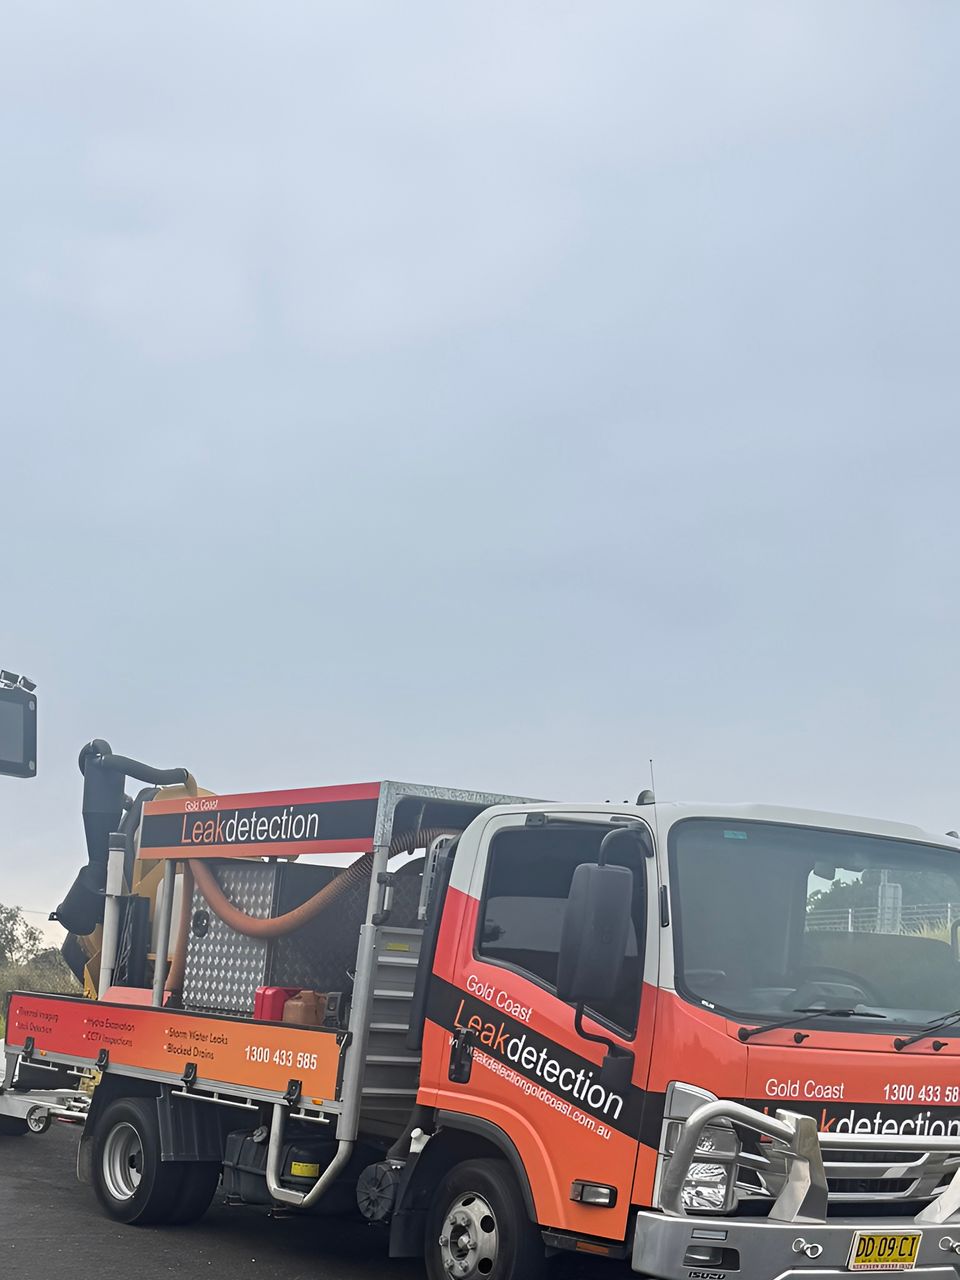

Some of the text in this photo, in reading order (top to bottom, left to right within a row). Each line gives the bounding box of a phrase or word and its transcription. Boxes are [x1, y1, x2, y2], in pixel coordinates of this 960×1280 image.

[181, 807, 319, 844] Leakdetection
[466, 974, 533, 1023] Gold Coast
[245, 1045, 318, 1070] 1300 433 585
[454, 1000, 623, 1120] Leakdetection
[765, 1078, 800, 1097] Gold
[804, 1079, 845, 1099] Coast
[883, 1083, 914, 1101] 1300
[918, 1084, 941, 1102] 433
[688, 1271, 726, 1280] ISUZU
